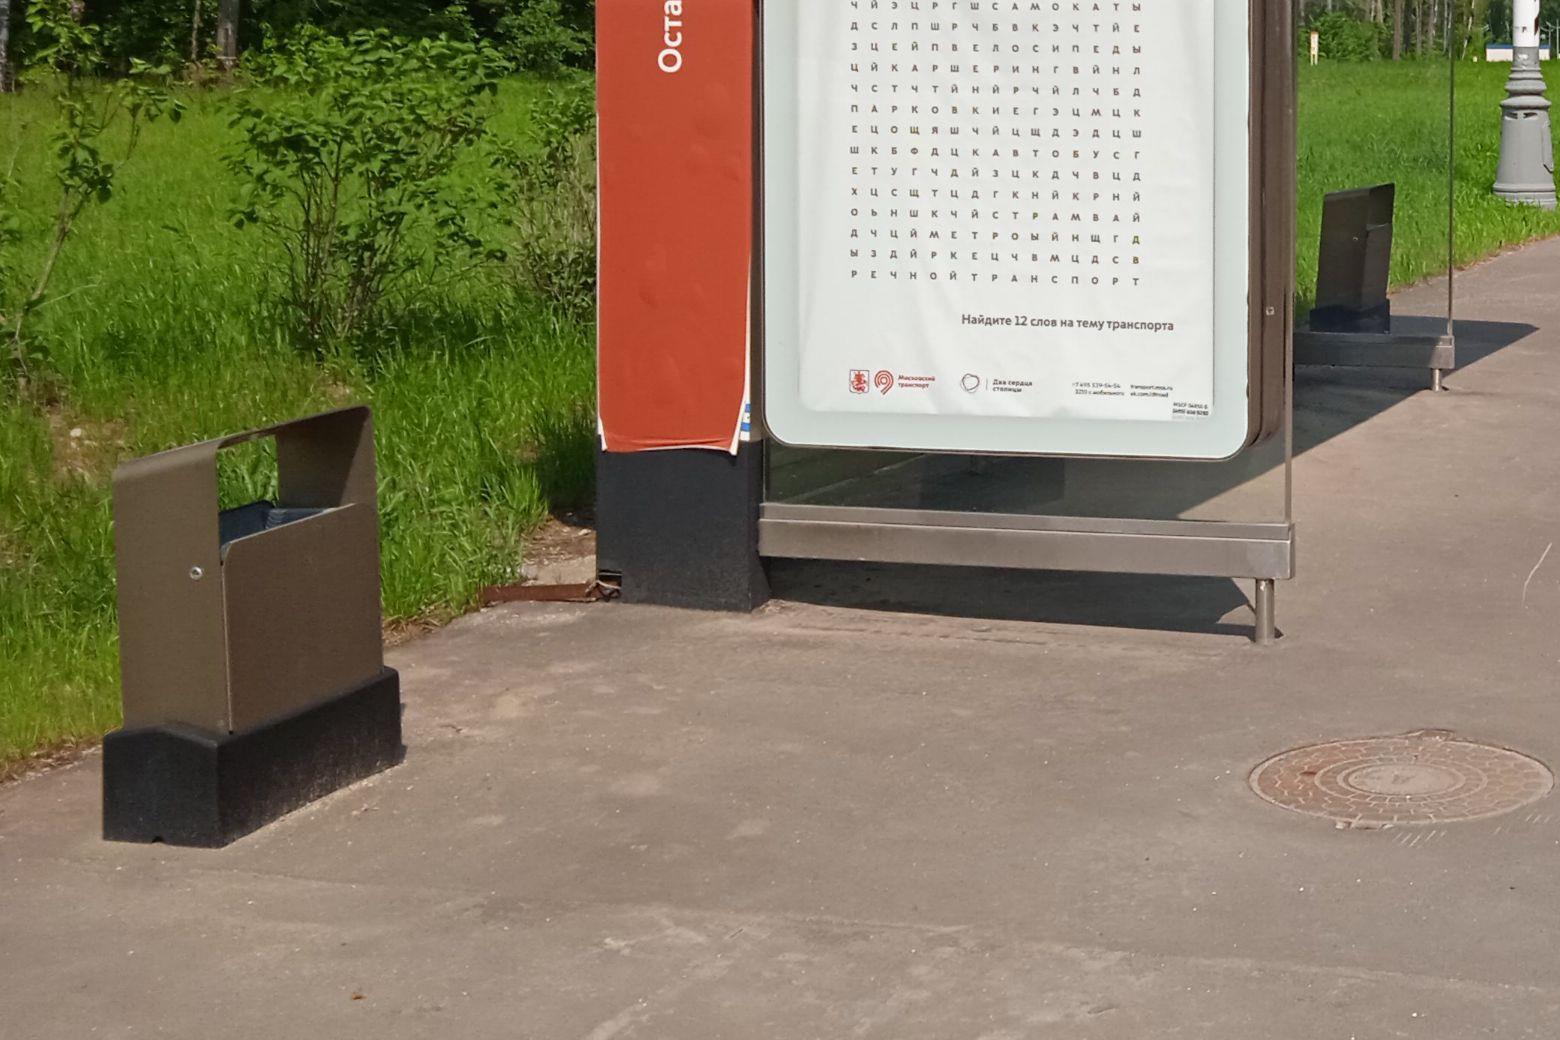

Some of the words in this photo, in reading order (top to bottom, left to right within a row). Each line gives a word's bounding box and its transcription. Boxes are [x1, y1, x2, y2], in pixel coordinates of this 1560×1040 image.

[961, 314, 1012, 327] Найдите
[1014, 315, 1028, 326] 12
[1030, 318, 1058, 327] слов
[1060, 319, 1074, 328] на
[1076, 319, 1105, 331] тему
[1106, 320, 1174, 332] транспорта
[1008, 379, 1033, 387] сердца
